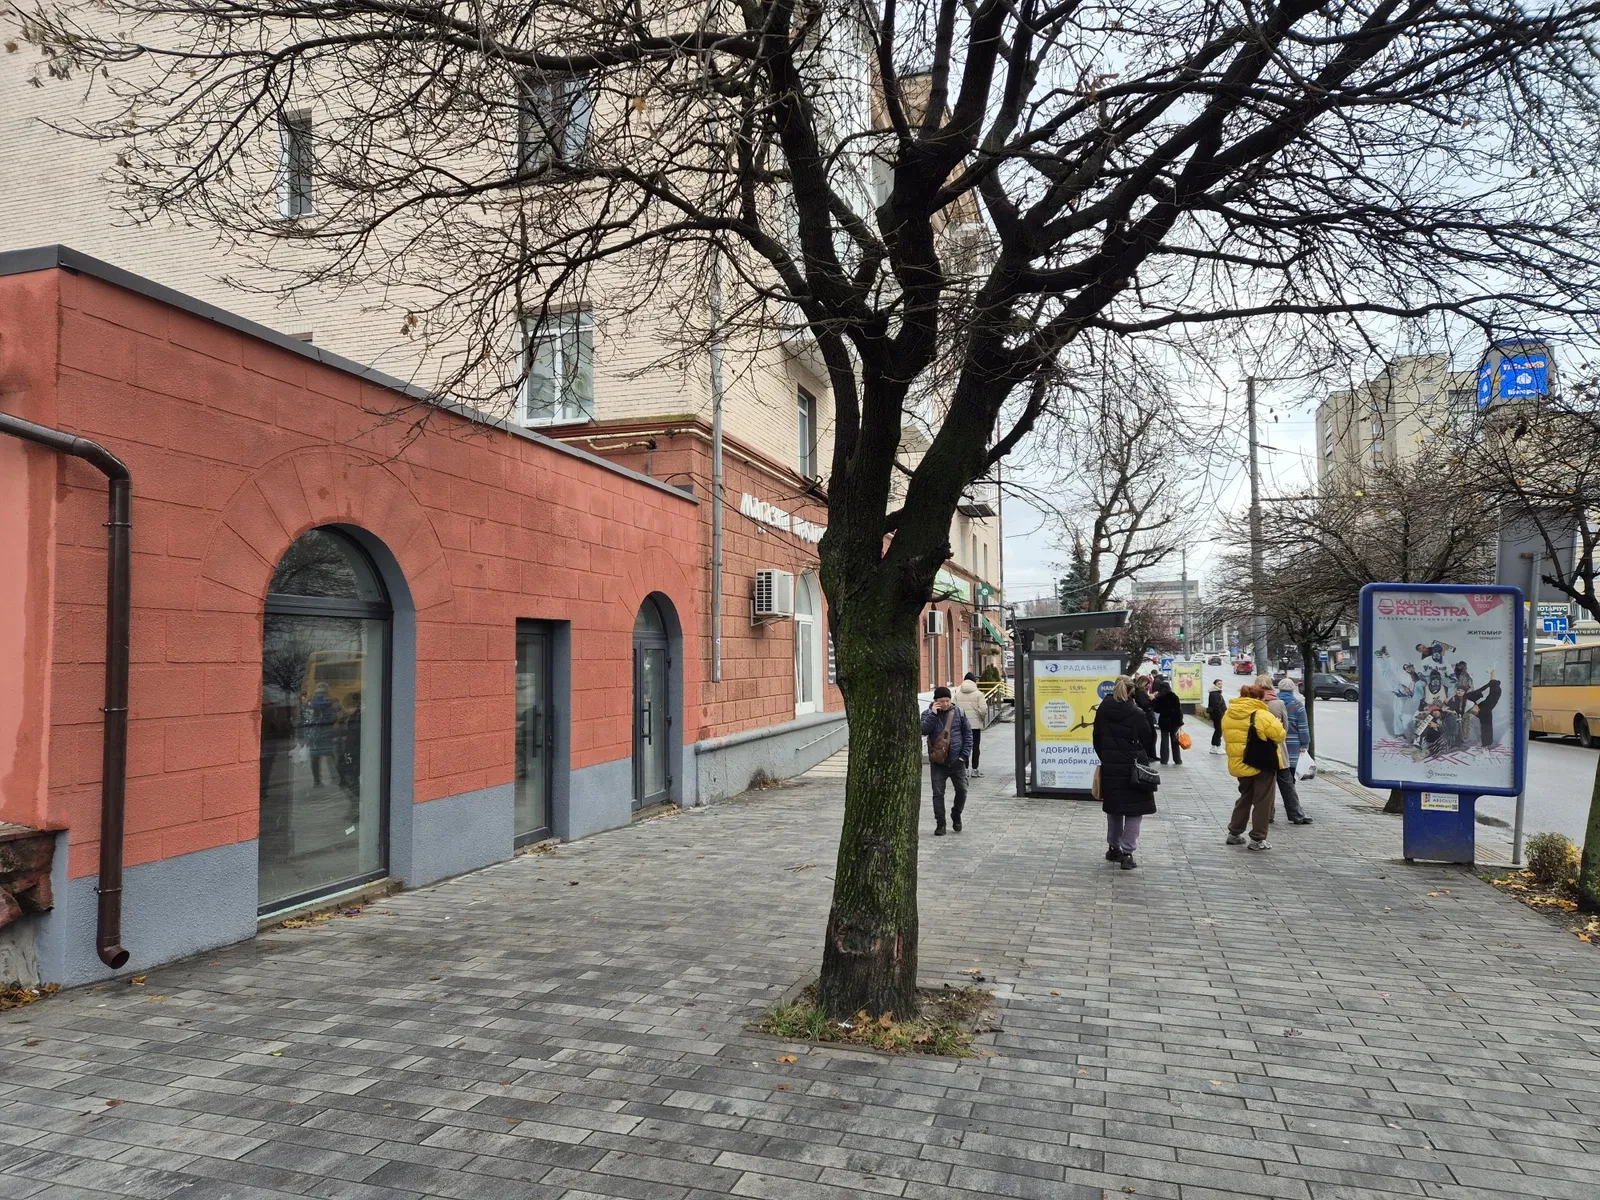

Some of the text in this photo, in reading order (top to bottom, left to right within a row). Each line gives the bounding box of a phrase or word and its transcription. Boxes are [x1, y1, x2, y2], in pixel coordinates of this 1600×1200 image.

[1063, 664, 1108, 672] РАДАБАНК
[1041, 746, 1080, 754] «ДОБРИЙ
[1058, 757, 1087, 765] добрих
[1089, 758, 1101, 766] др
